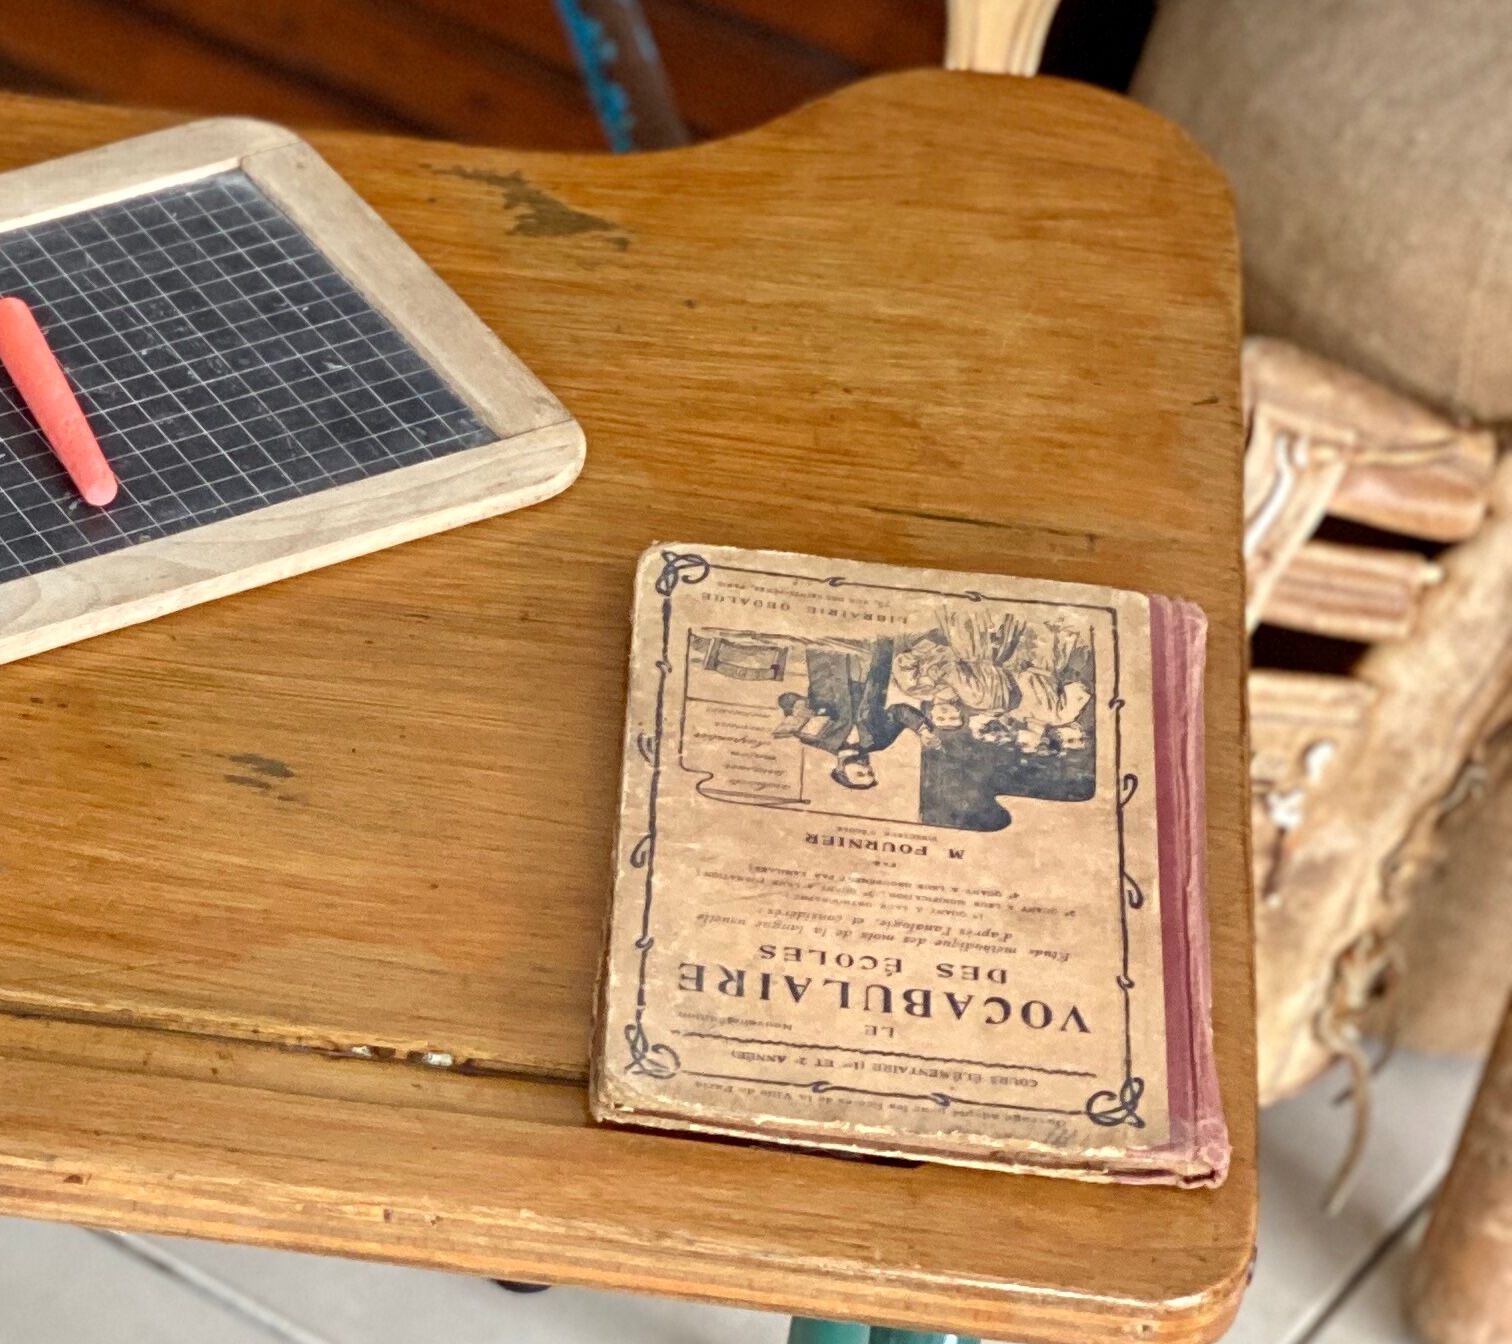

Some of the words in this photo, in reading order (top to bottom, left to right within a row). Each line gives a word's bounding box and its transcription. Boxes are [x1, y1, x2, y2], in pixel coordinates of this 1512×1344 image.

[806, 605, 908, 626] LIBRAIRIE
[804, 832, 928, 856] FOURNIER
[695, 912, 746, 928] usuelle
[753, 917, 804, 934] langue
[813, 926, 827, 937] la
[835, 928, 853, 940] de
[958, 925, 1013, 943] d'après
[902, 935, 927, 948] des
[933, 935, 1017, 958] méthodique
[757, 941, 903, 978] ÉCOLES
[934, 961, 1008, 986] DES
[674, 960, 1090, 1033] VOCABULAIRE
[863, 1024, 894, 1039] LE
[730, 1049, 787, 1066] ANNÉE)
[814, 1057, 834, 1069] ET
[871, 1061, 982, 1085] ÉLÉMENTAIRE
[989, 1074, 1039, 1089] COURS
